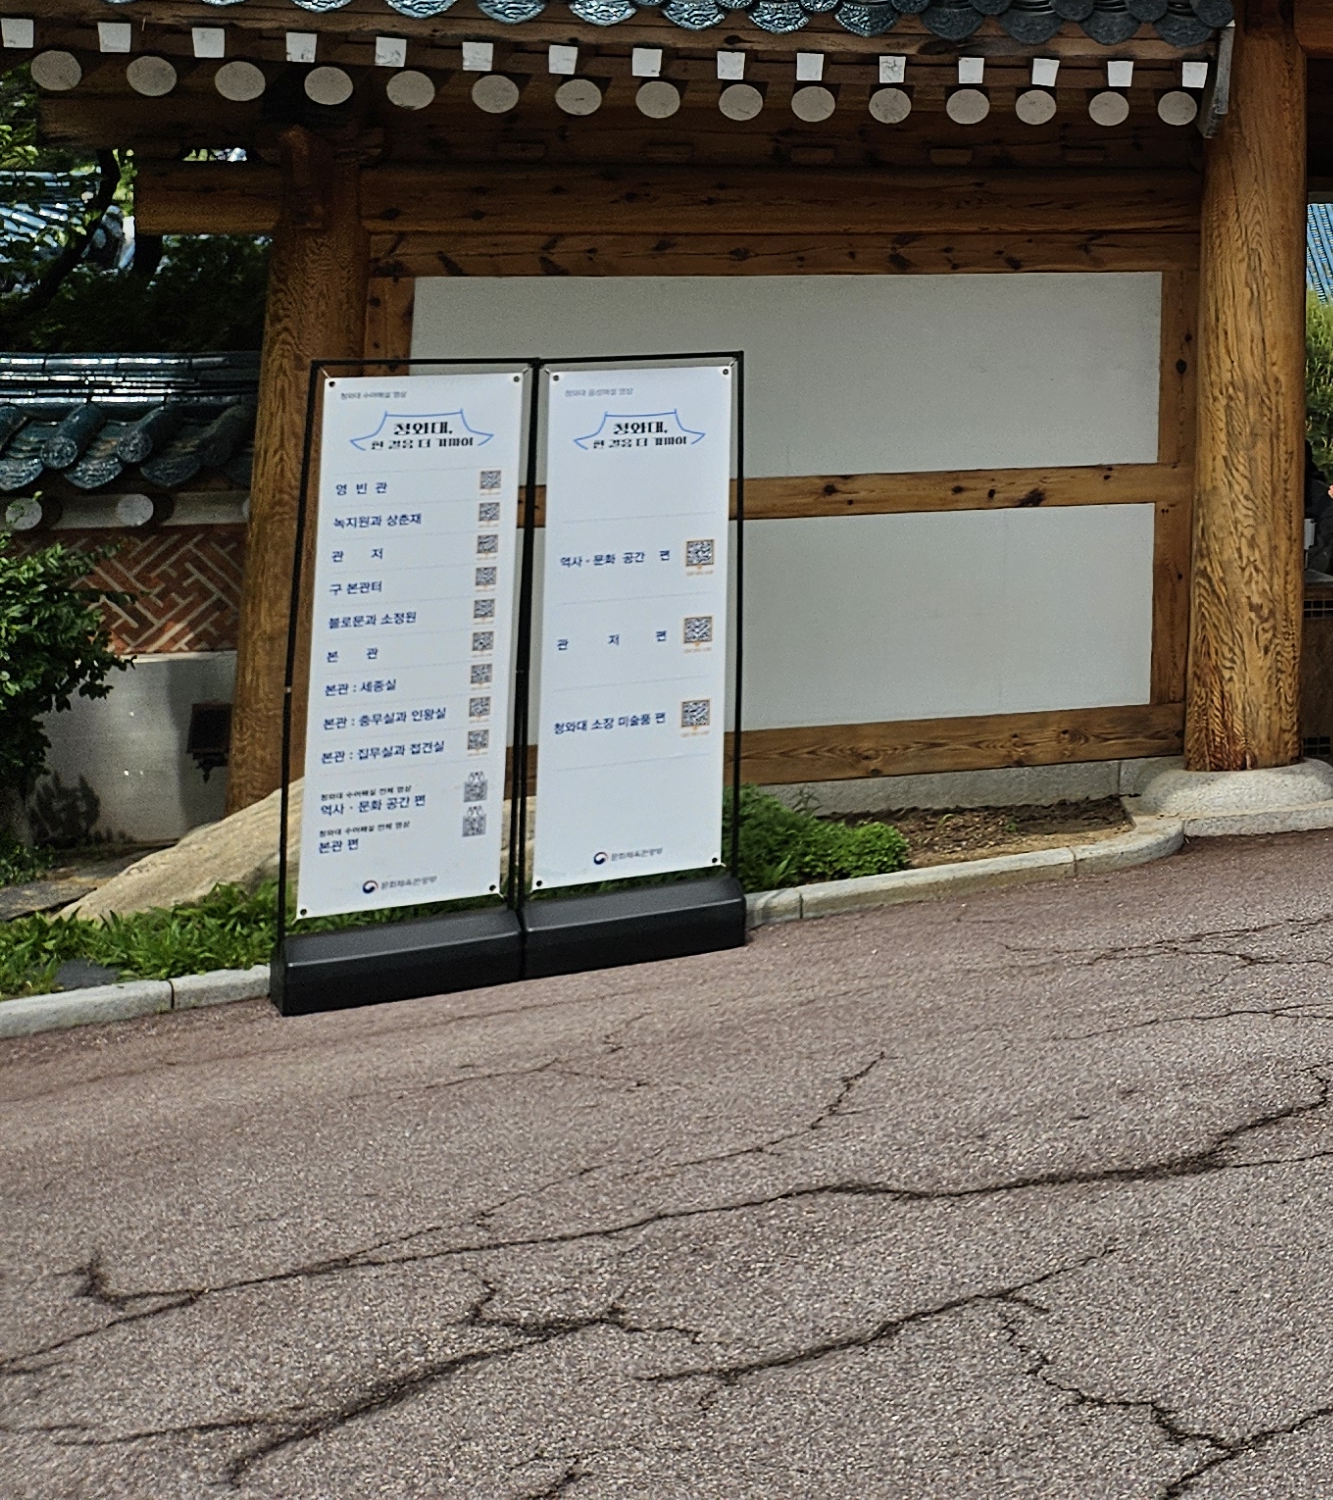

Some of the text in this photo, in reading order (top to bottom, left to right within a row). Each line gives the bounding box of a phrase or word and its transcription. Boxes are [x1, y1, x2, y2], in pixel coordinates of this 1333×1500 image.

[333, 513, 422, 529] 녹지원과 상춘재
[560, 556, 583, 568] 역사
[593, 553, 617, 566] 문화
[622, 552, 645, 564] 공간
[659, 550, 671, 562] 편
[329, 581, 383, 595] 구 본관터
[380, 611, 417, 625] 소정원
[655, 630, 667, 642] 편
[325, 682, 349, 696] 본관
[359, 678, 397, 693] 세종실
[323, 717, 347, 730] 본관
[359, 711, 407, 727] 충무실과
[411, 707, 447, 722] 인왕실
[554, 711, 666, 735] 청와대 소장 미술품 편
[321, 750, 345, 764] 본관
[357, 744, 405, 760] 집무실과
[409, 740, 445, 755] 접견실
[320, 803, 344, 816] 역사
[358, 799, 382, 813] 문화
[386, 796, 410, 810] 공간
[414, 794, 426, 807] 편
[318, 838, 359, 854] 본관 편
